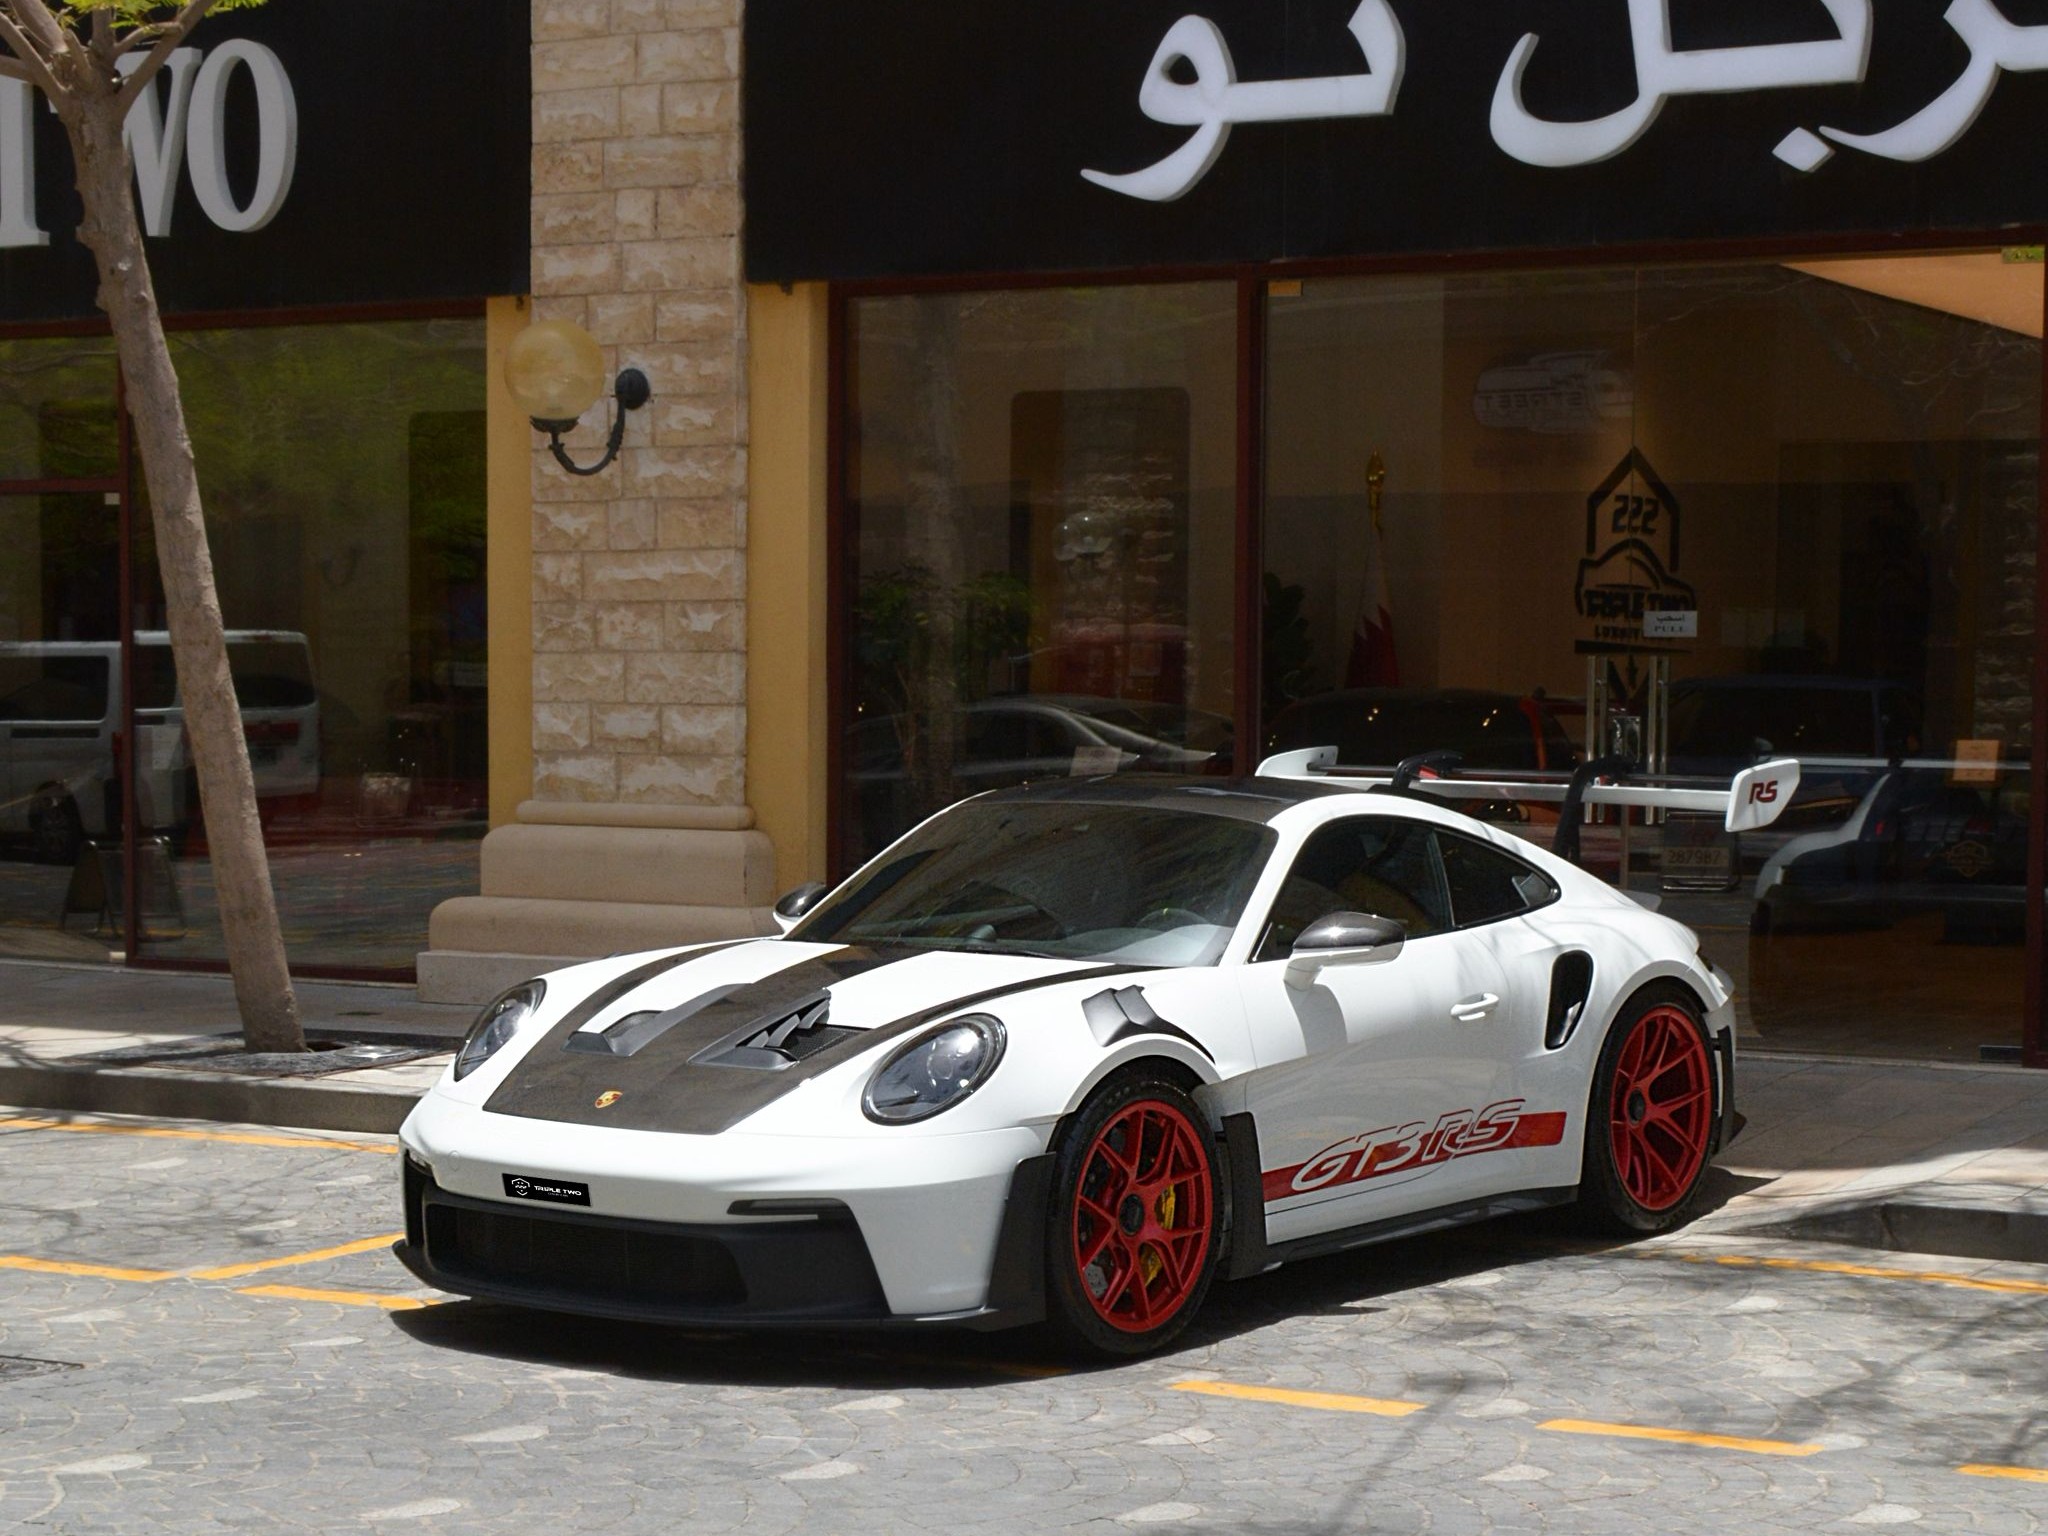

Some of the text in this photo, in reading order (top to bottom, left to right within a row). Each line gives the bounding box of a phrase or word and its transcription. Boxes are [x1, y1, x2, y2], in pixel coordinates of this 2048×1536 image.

[1489, 0, 2048, 171] ربل
[1612, 495, 1660, 534] 222
[1749, 780, 1778, 804] RS
[534, 1185, 561, 1194] TRIPLE
[562, 1188, 582, 1196] TWO
